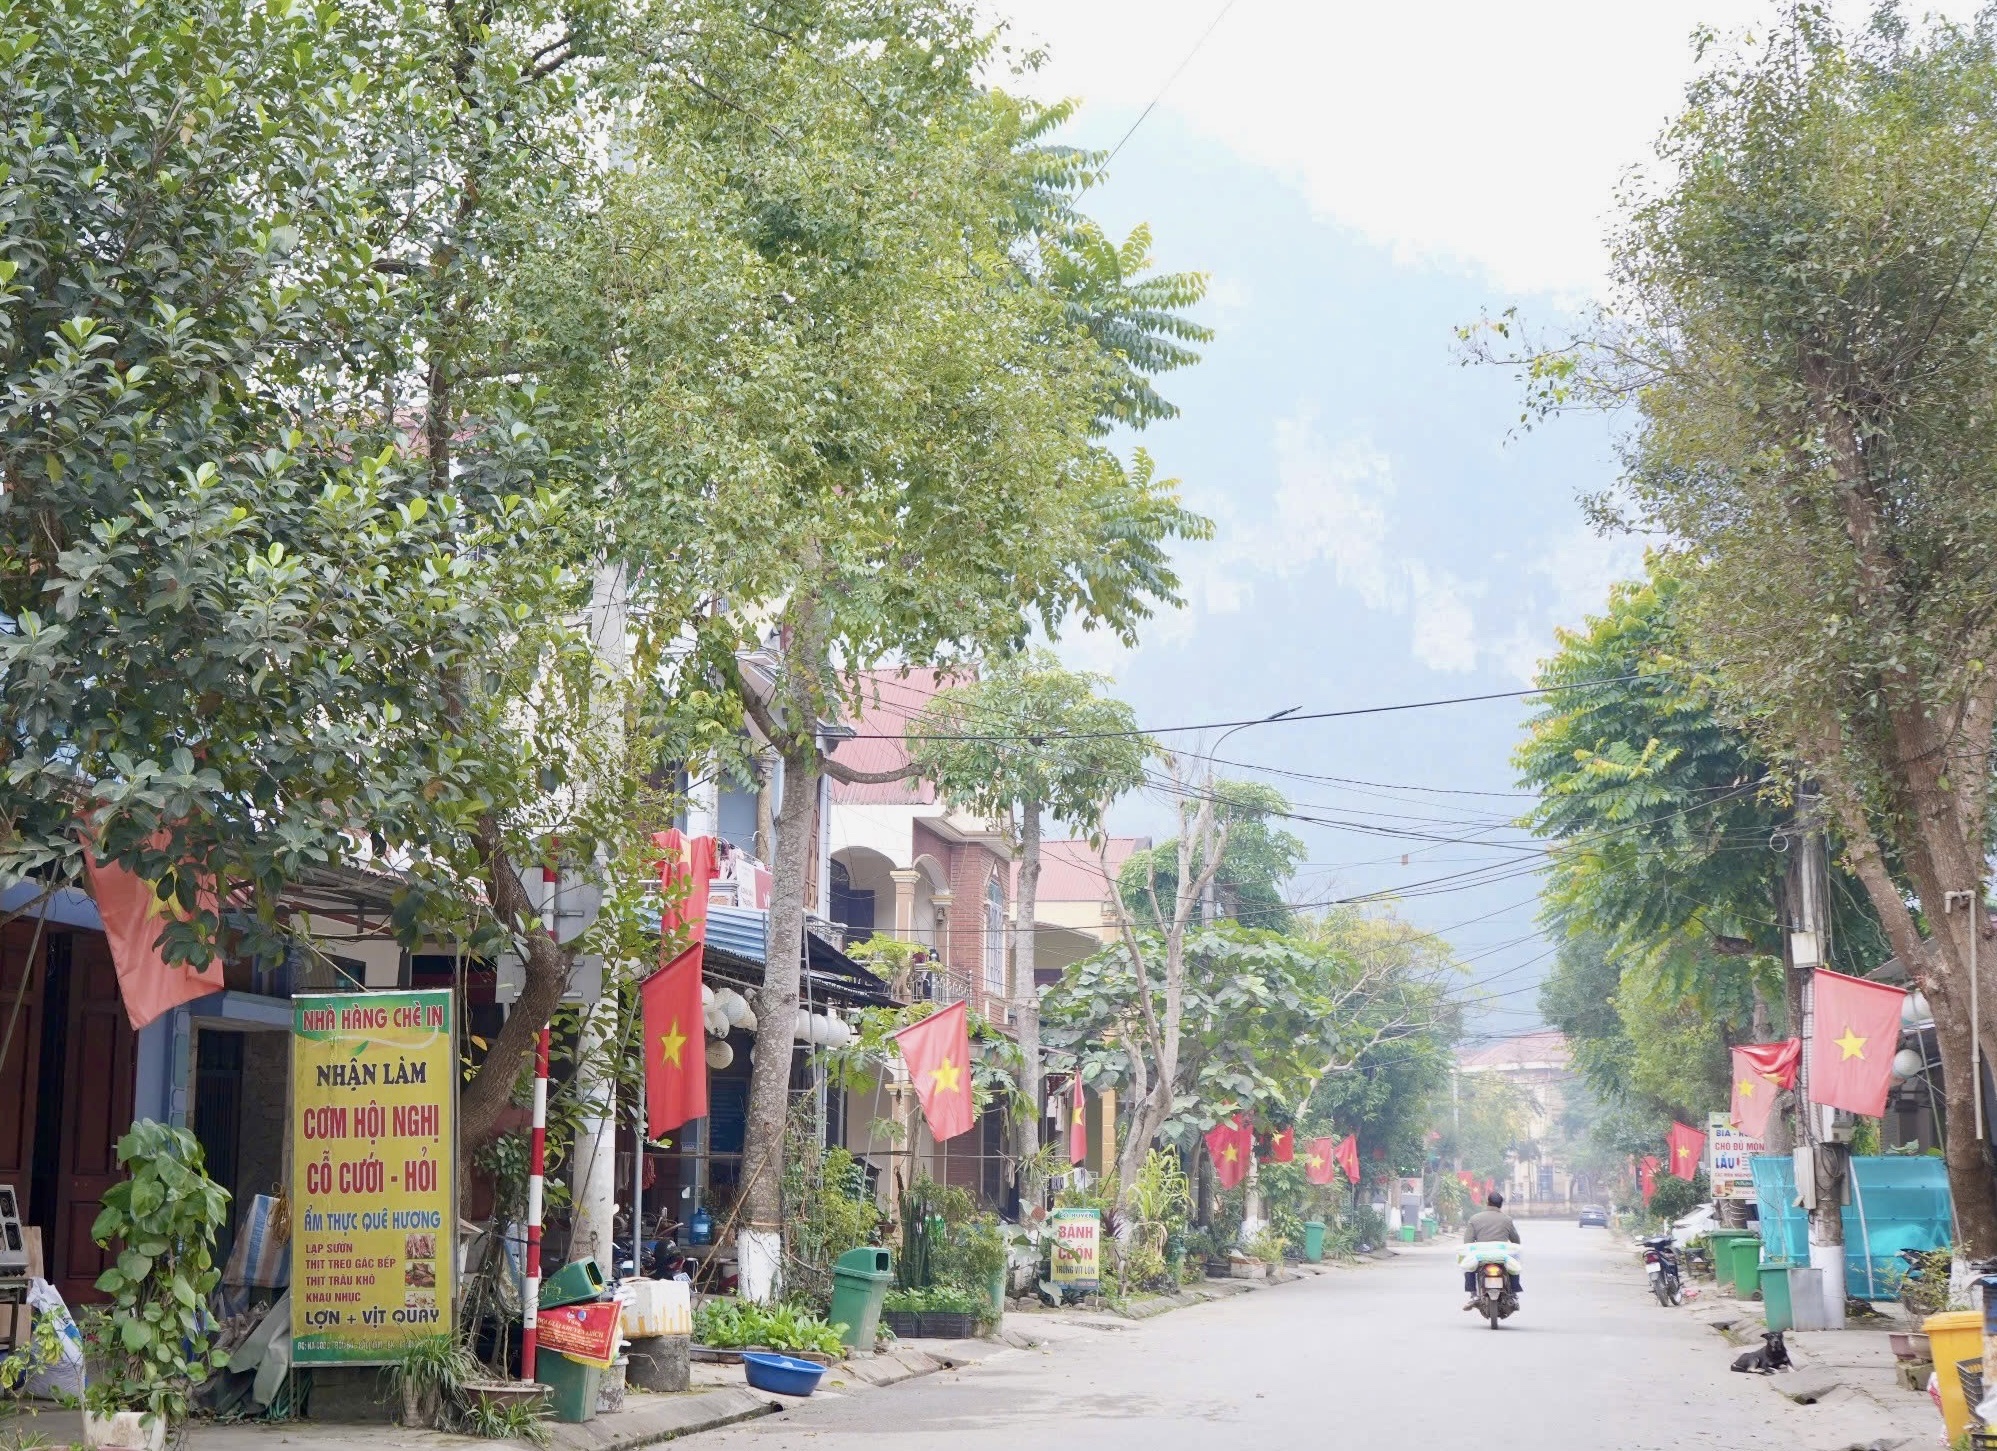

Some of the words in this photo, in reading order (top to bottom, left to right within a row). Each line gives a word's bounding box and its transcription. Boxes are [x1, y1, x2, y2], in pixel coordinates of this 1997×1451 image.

[303, 1004, 336, 1031] NHÀ
[341, 1003, 388, 1030] HÀNG
[393, 1001, 421, 1028] CHÈ
[426, 1005, 443, 1027] IN
[316, 1057, 377, 1091] NHẬN
[383, 1056, 427, 1085] LÀM
[303, 1105, 347, 1139] CƠM
[354, 1099, 386, 1145] HỘI
[393, 1105, 439, 1143] NGHỊ
[1716, 1129, 1731, 1137] BIA
[1715, 1152, 1734, 1169] LẨU
[307, 1150, 332, 1194] CỖ
[339, 1152, 384, 1193] CƯỚI
[405, 1146, 436, 1192] HỎI
[304, 1205, 323, 1231] ẨM
[327, 1212, 358, 1236] THỰC
[362, 1208, 387, 1232] QUÊ
[393, 1210, 441, 1229] HƯƠNG
[1058, 1223, 1093, 1239] BÁNH
[305, 1243, 324, 1255] LẠP
[327, 1241, 353, 1254] SƯỜN
[305, 1260, 325, 1271] THỊT
[328, 1259, 352, 1269] TREO
[355, 1257, 374, 1269] GÁC
[377, 1255, 396, 1268] BẾP
[305, 1276, 325, 1288] THỊT
[328, 1274, 353, 1286] TRÂU
[355, 1274, 375, 1285] KHÔ
[306, 1293, 331, 1302] KHAU
[335, 1292, 361, 1304] NHỤC
[305, 1310, 340, 1329] LỢN
[347, 1315, 356, 1324] +
[362, 1306, 386, 1328] VỊT
[392, 1309, 440, 1324] QUAY
